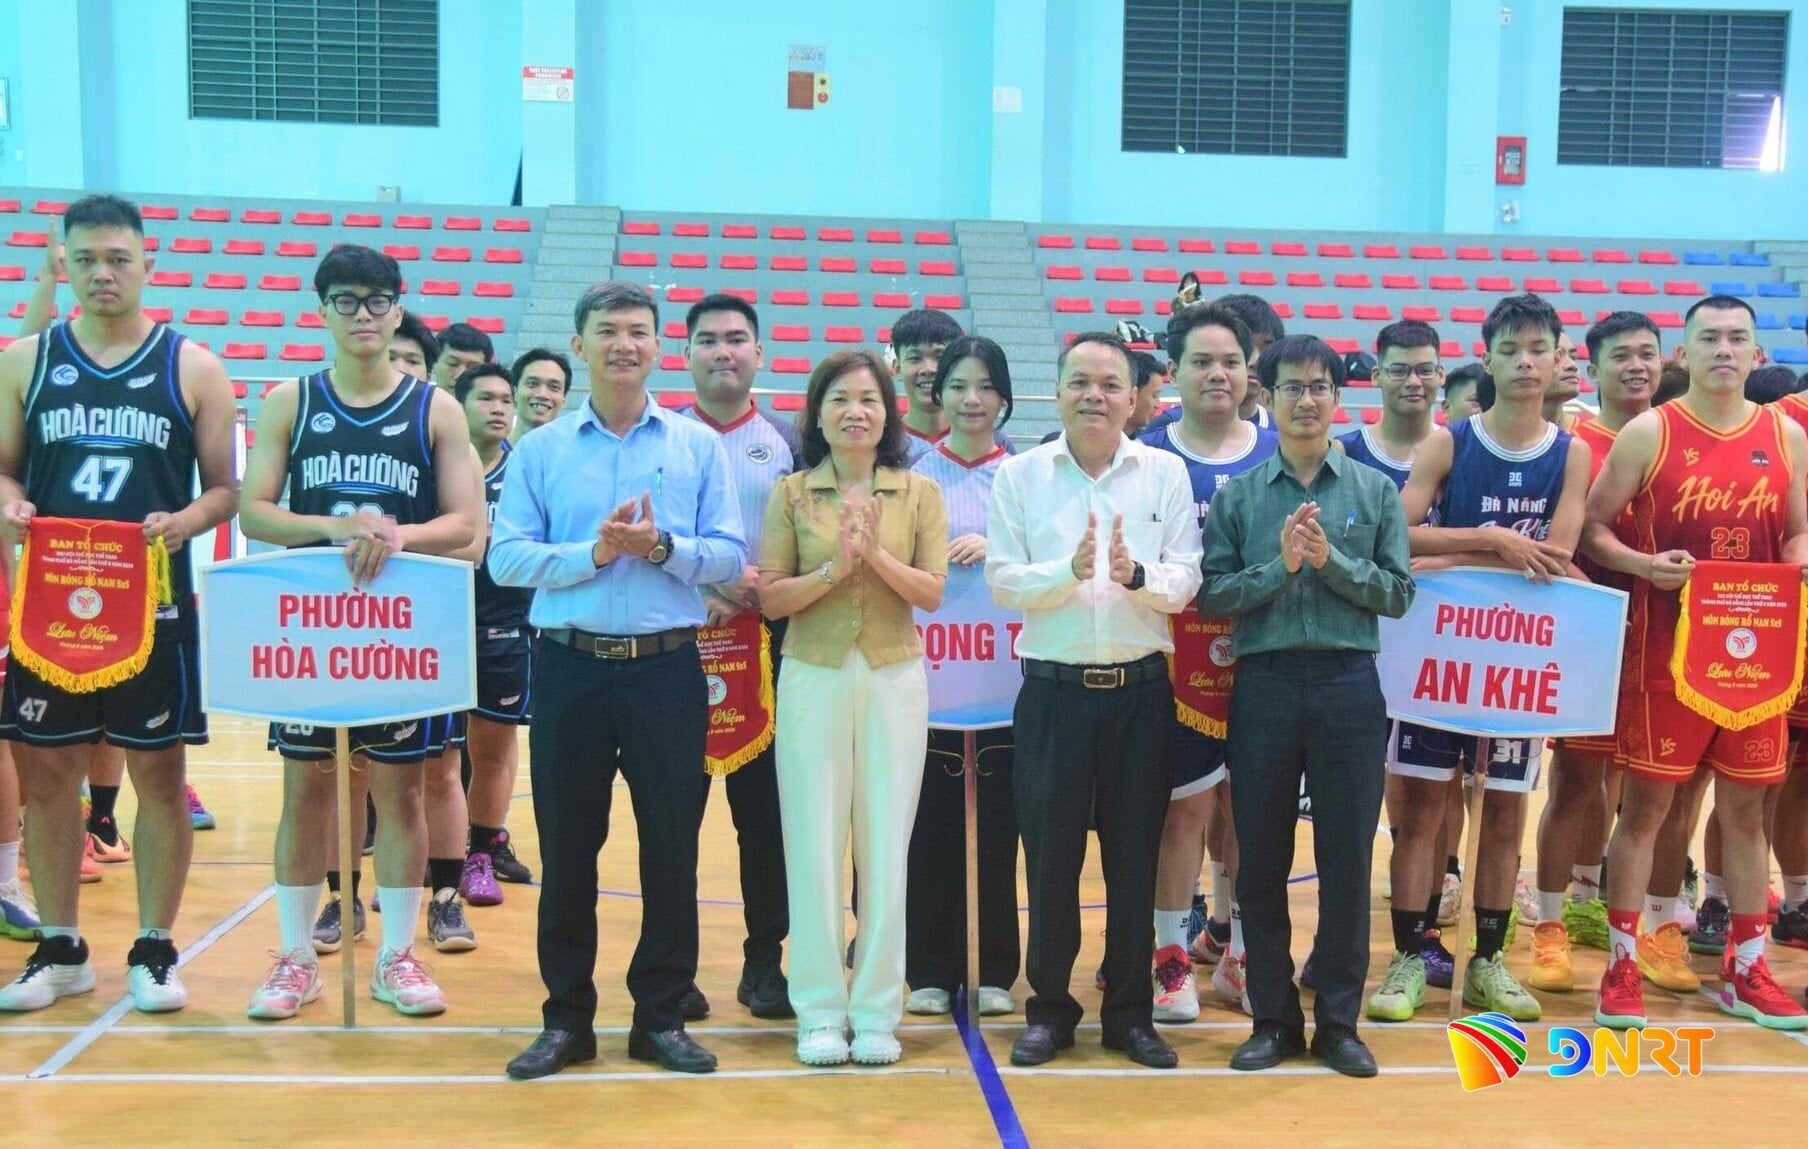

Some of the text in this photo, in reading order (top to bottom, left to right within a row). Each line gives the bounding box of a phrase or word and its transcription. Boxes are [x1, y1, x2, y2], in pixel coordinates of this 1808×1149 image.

[70, 454, 134, 502] 47
[1737, 475, 1779, 520] An
[50, 539, 74, 549] BAN
[1710, 526, 1750, 559] 23
[278, 586, 413, 630] PHƯỜNG
[1712, 582, 1734, 592] BAN
[915, 622, 996, 670] ỌNG
[1435, 602, 1555, 647] PHƯỜNG
[252, 637, 439, 681] HÒA CƯỜNG
[1413, 657, 1562, 715] AN KHÊ
[19, 697, 48, 723] 47
[1493, 738, 1522, 765] 31
[1744, 738, 1774, 764] 23
